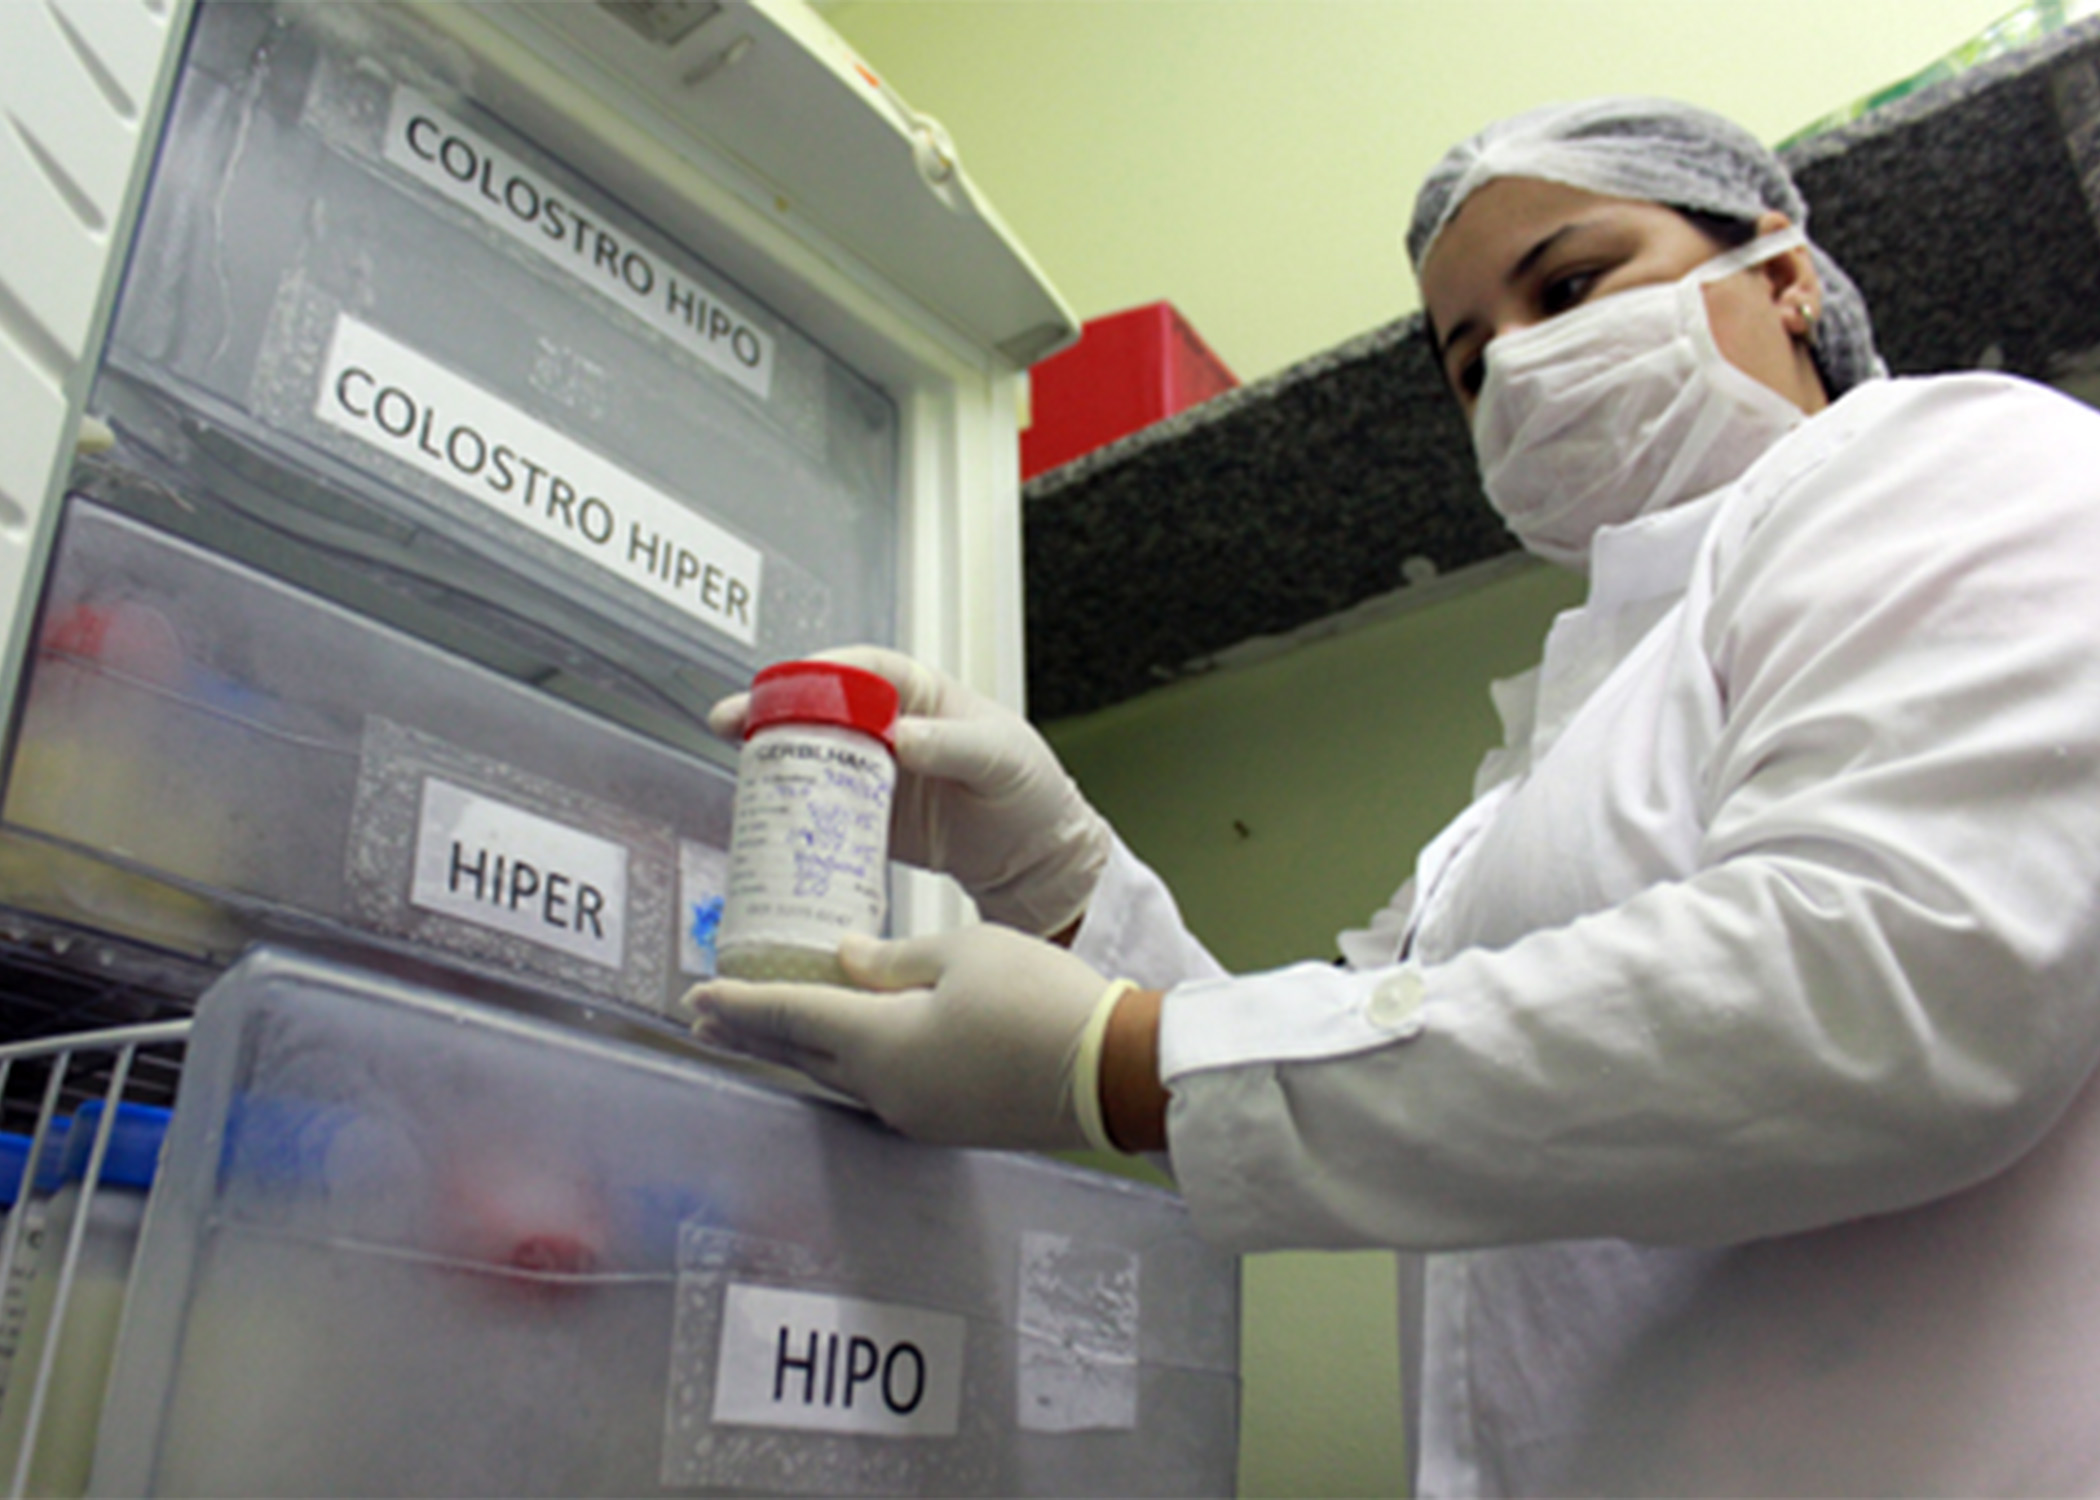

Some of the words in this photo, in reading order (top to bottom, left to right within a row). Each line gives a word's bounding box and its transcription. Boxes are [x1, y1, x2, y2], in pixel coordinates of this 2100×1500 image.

[406, 114, 655, 296] COLOSTRO
[666, 278, 762, 368] HIPO
[335, 366, 616, 546] COLOSTRO
[627, 521, 751, 626] HIPER
[449, 840, 605, 940] HIPER
[772, 1325, 926, 1416] HIPO
